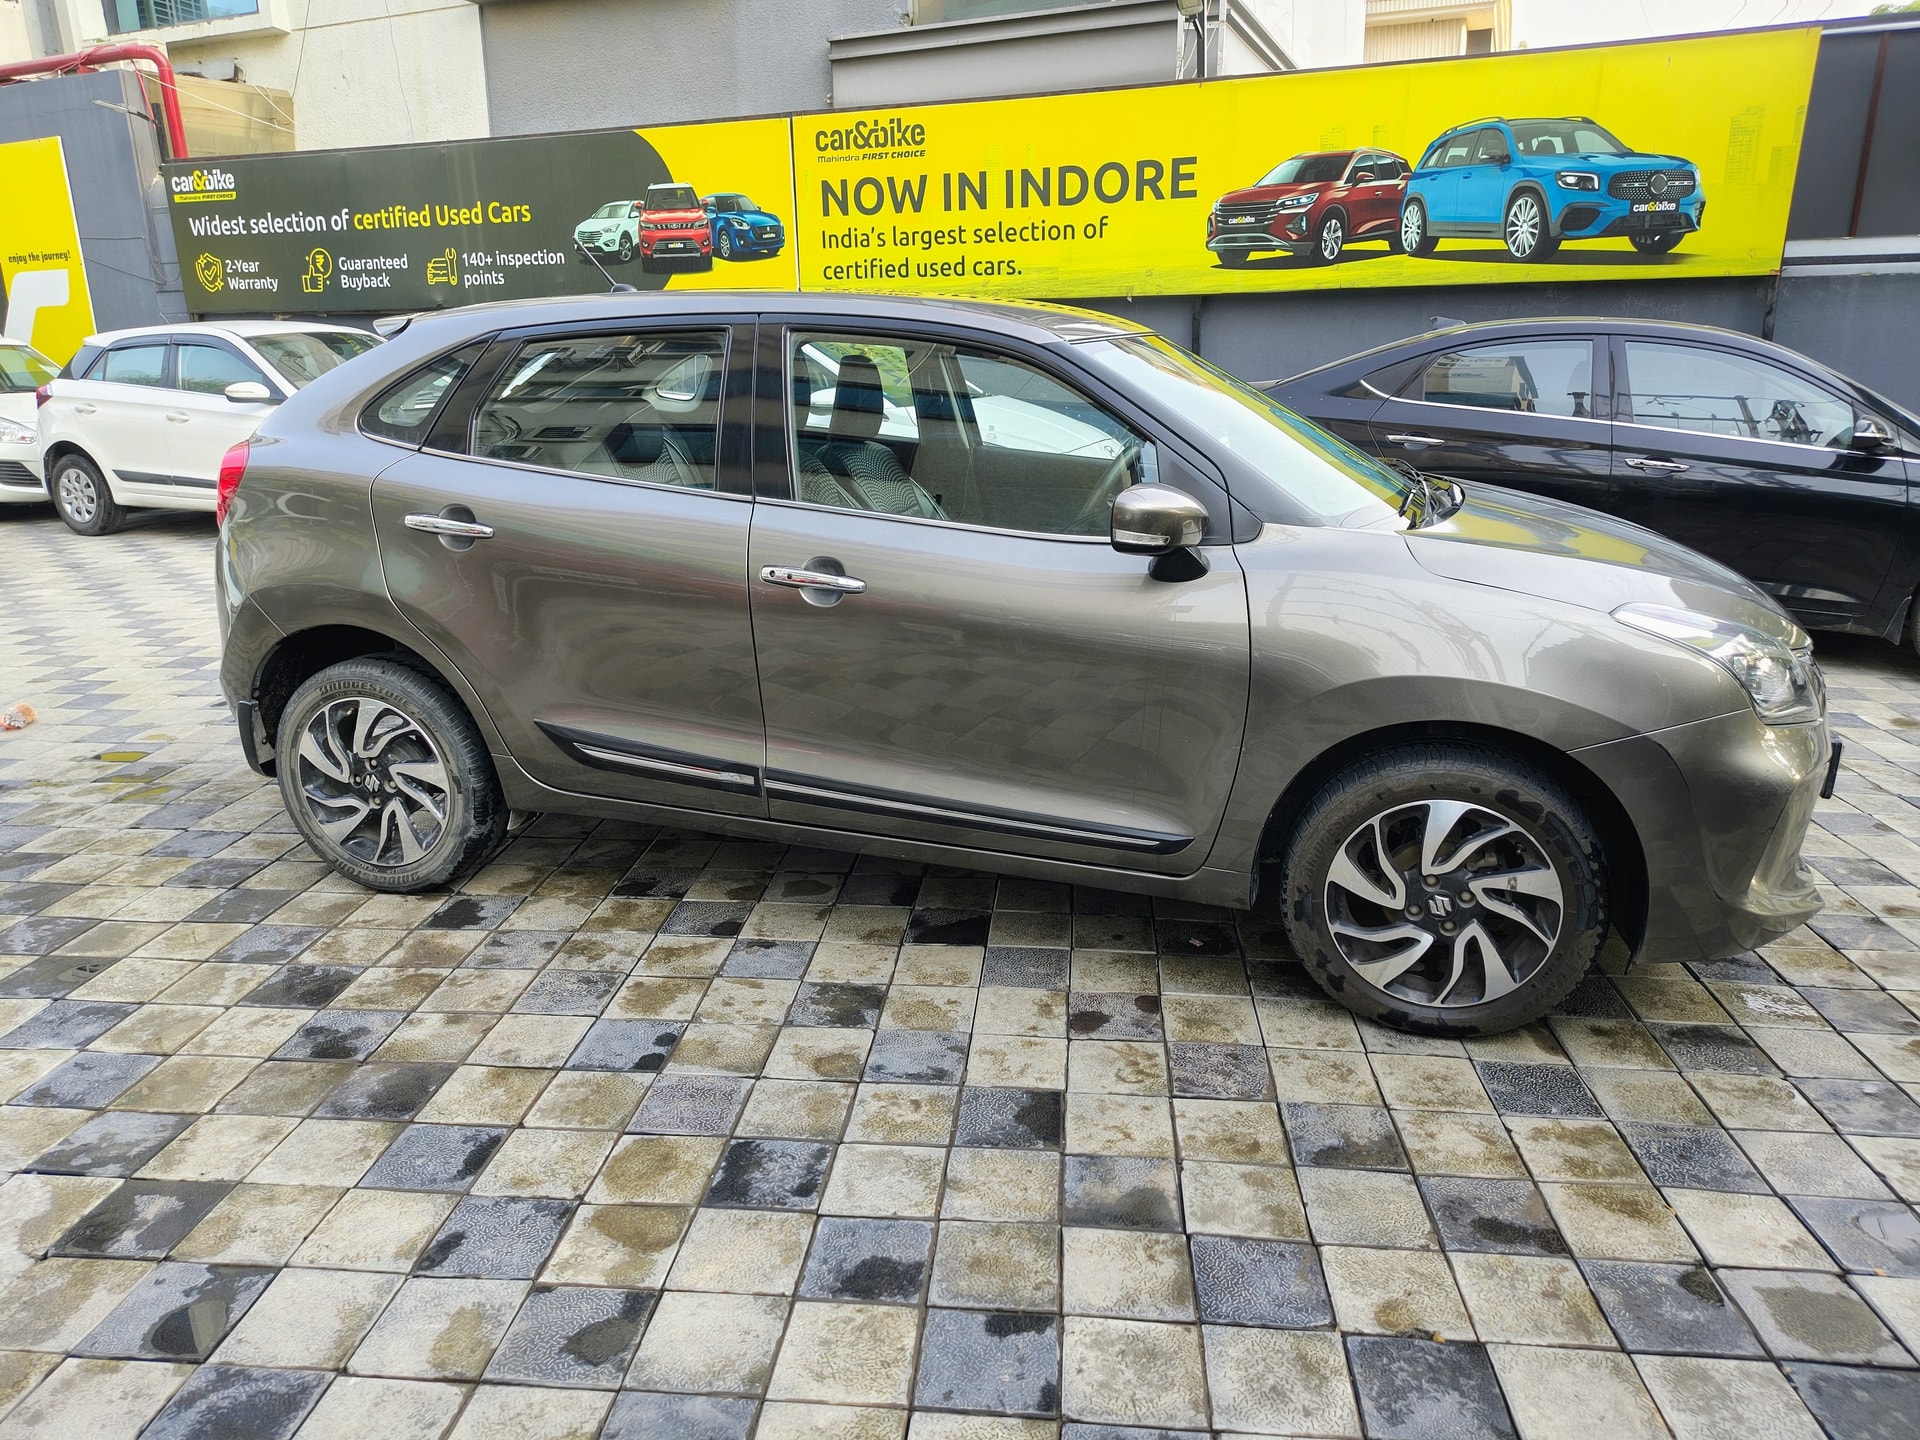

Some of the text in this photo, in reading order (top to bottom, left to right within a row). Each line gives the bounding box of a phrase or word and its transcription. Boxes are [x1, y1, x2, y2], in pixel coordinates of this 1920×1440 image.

[816, 118, 925, 152] car&bike
[817, 149, 926, 163] Mahindra FIRST CHOICE
[171, 168, 235, 192] car&bike
[821, 157, 1197, 217] NOW IN INDORE
[189, 201, 530, 236] Widest selection of certified Used Cars
[821, 216, 1108, 250] India's largest selection of
[8, 250, 71, 264] enjoy the journey!
[226, 260, 259, 272] 2-Year
[339, 254, 408, 270] Guaranteed
[463, 249, 564, 268] 140+ inspection
[822, 255, 1023, 280] certified used cars.
[228, 277, 278, 291] Warranty
[341, 273, 390, 290] Buyback
[464, 270, 504, 288] points
